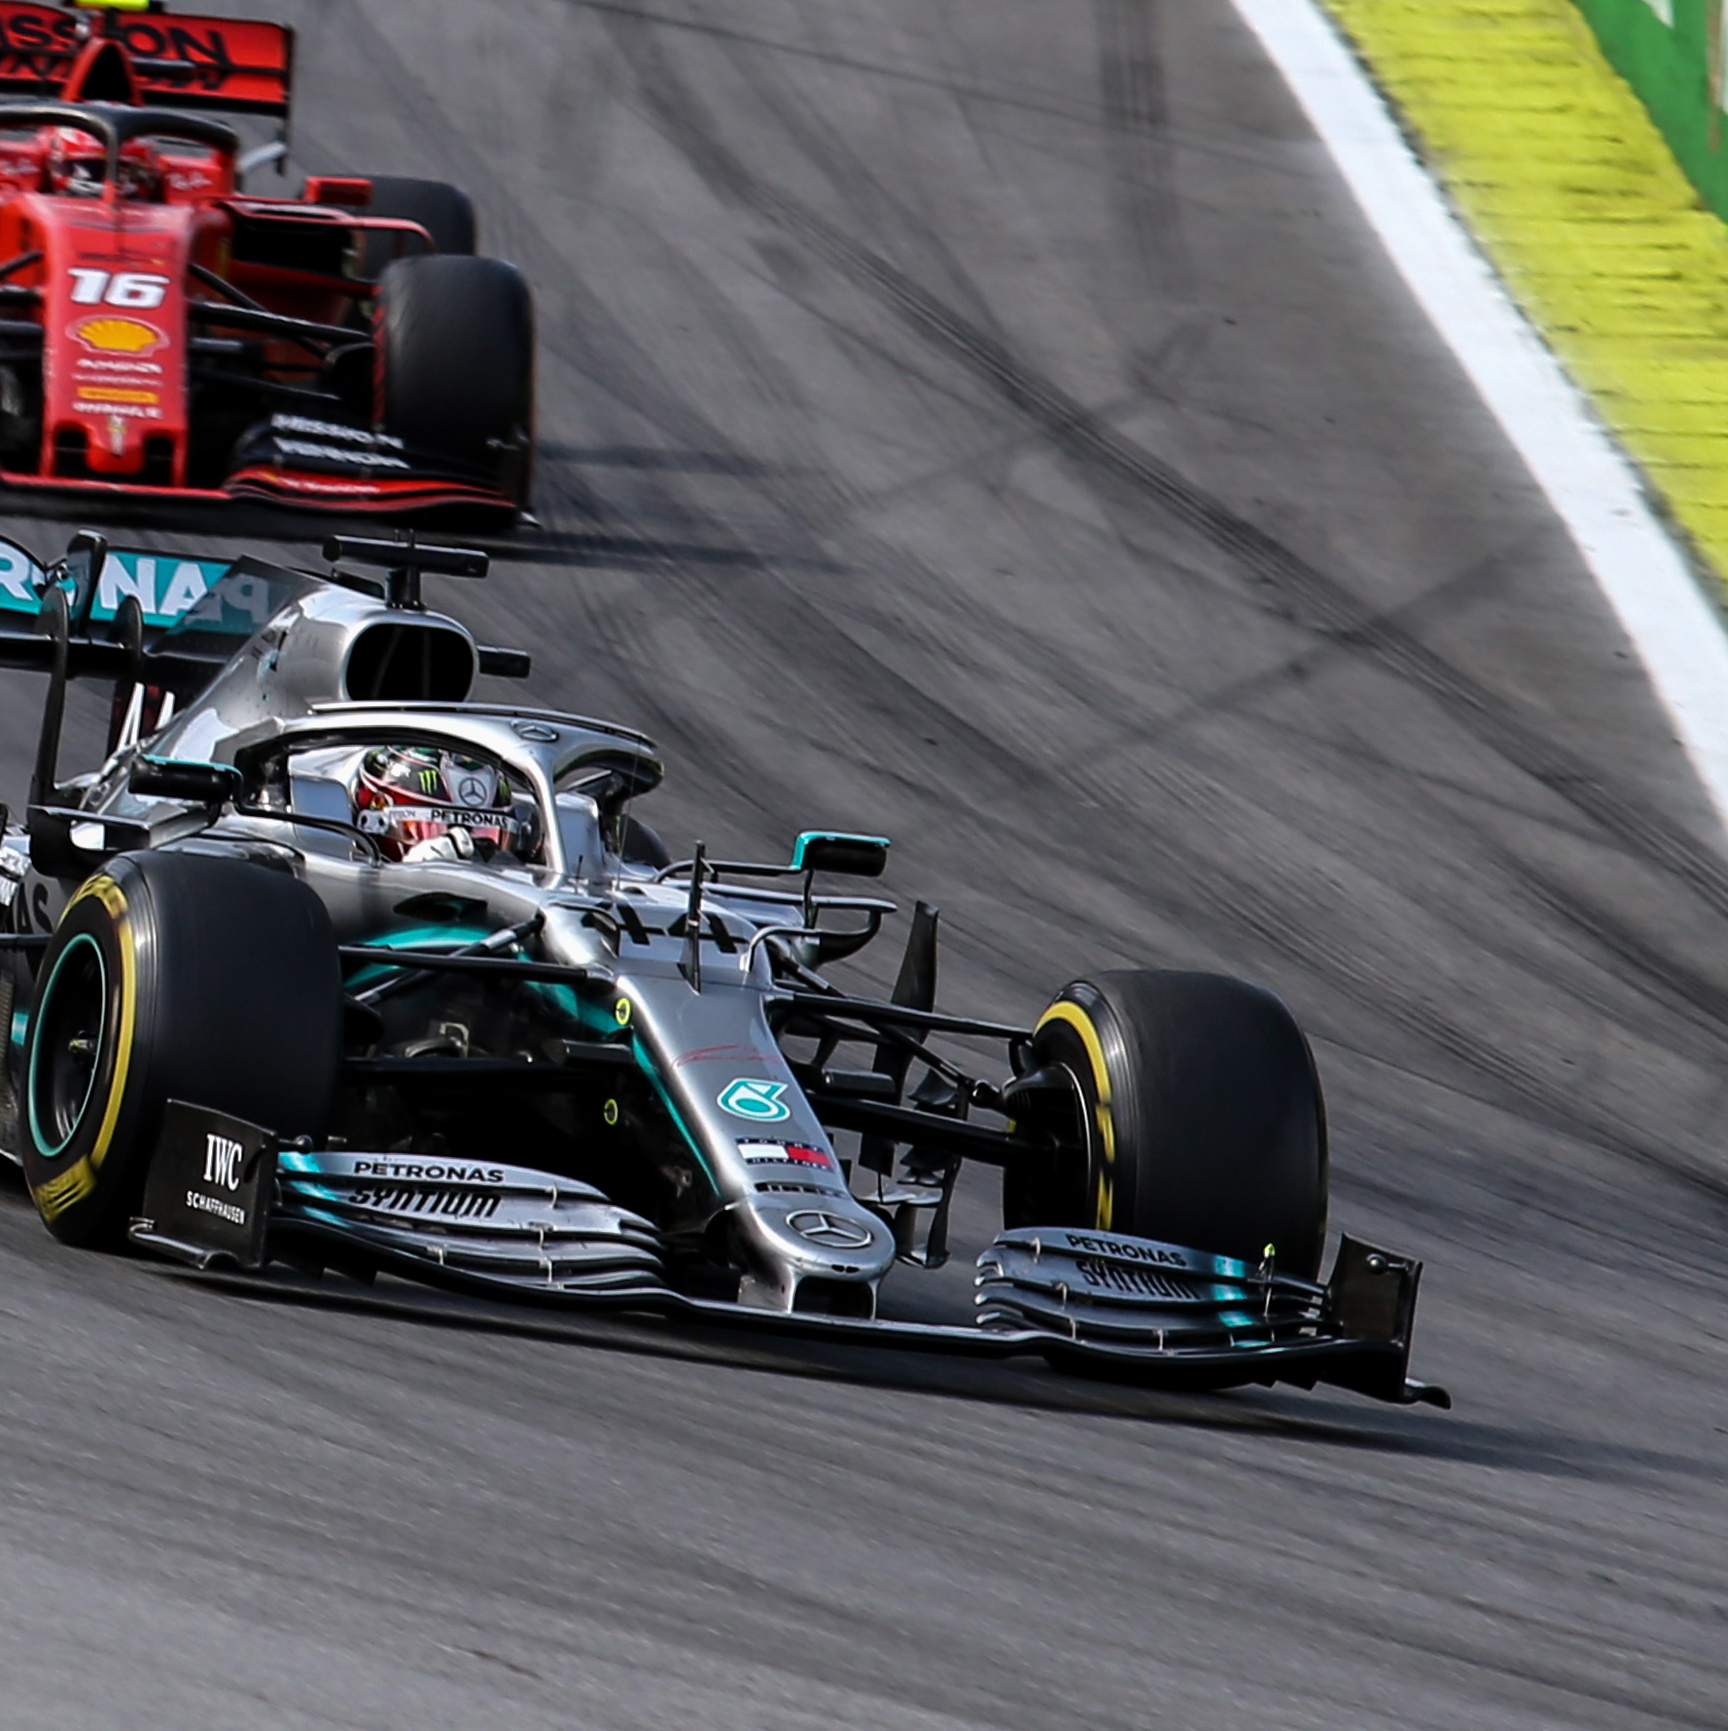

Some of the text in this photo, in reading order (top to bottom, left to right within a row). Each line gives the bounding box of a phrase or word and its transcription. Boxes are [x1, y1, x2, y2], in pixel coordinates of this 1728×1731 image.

[67, 266, 171, 309] 16
[431, 809, 509, 828] PETRONAS
[203, 1133, 243, 1192] IWC
[354, 1160, 505, 1184] PETRONAS
[185, 1190, 246, 1226] SCHAFFHAUSEN
[347, 1184, 503, 1219] SYNTIUM
[1065, 1233, 1188, 1267] PETRONAS
